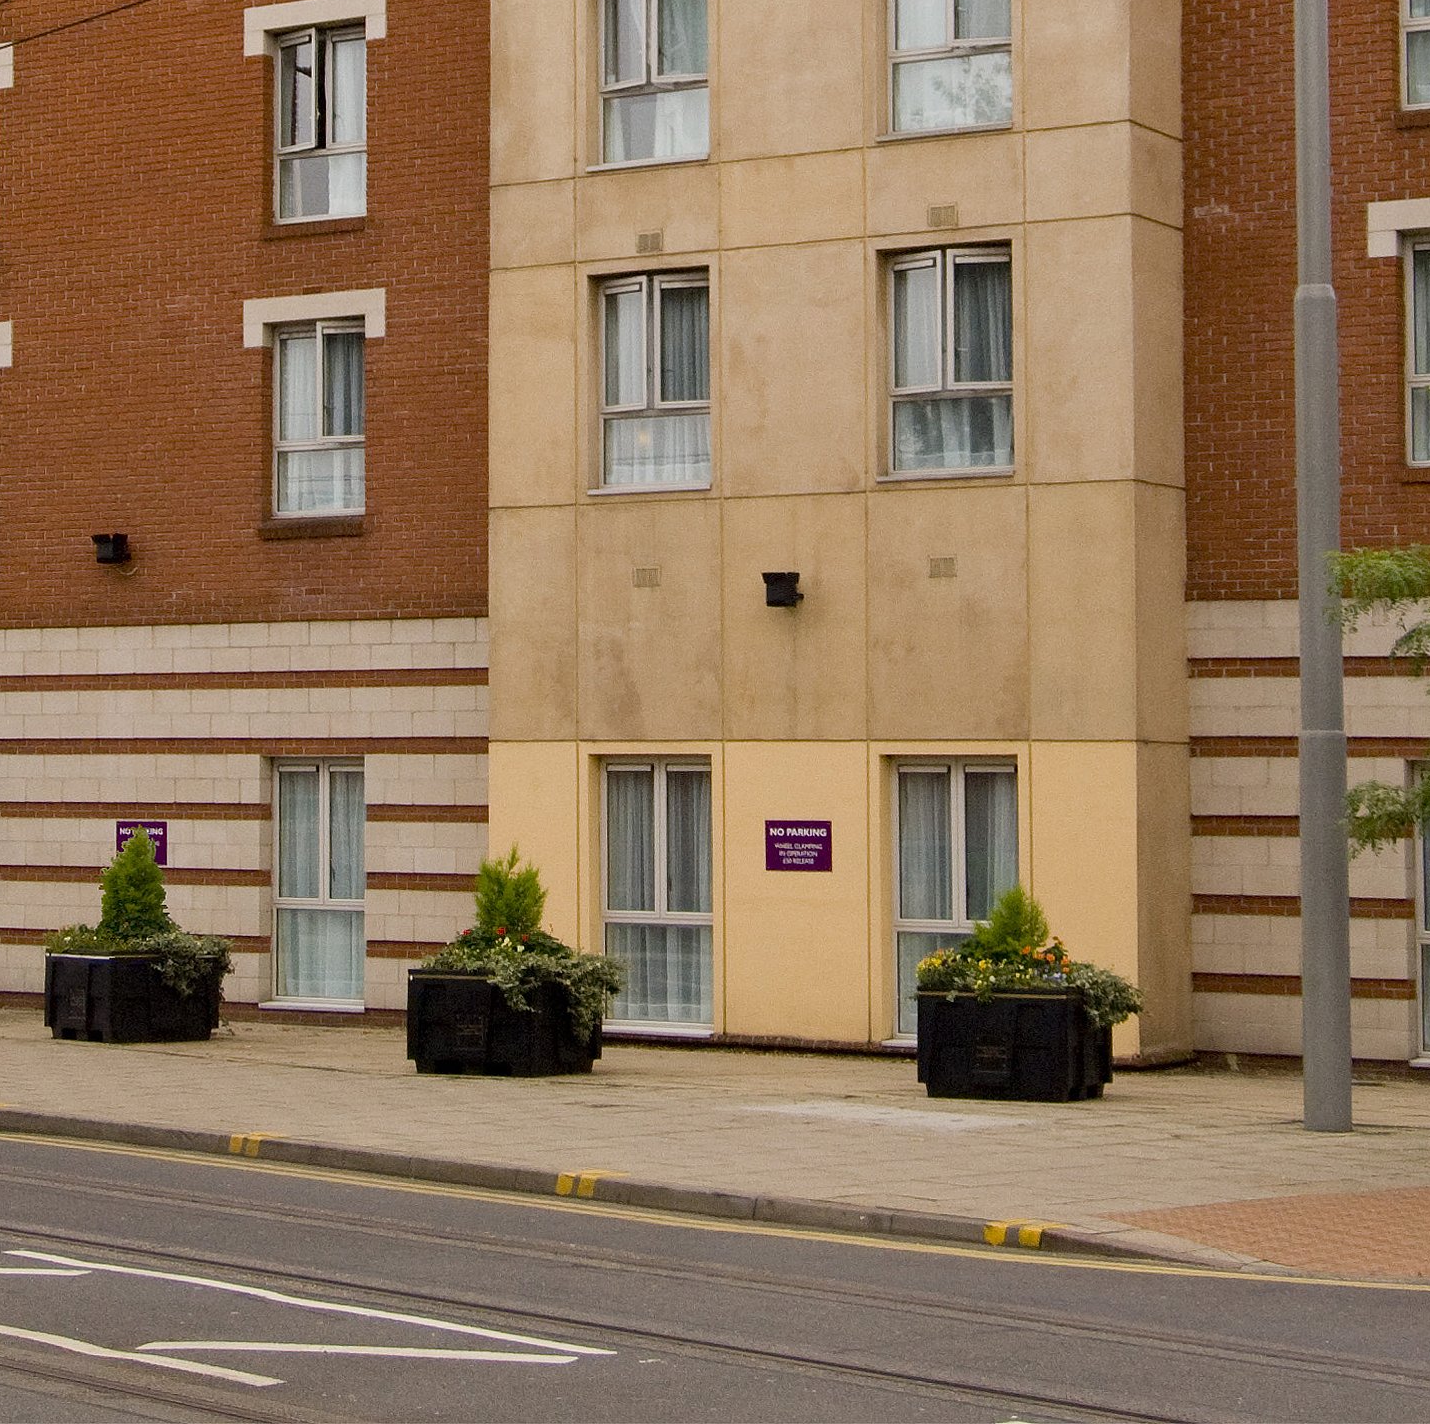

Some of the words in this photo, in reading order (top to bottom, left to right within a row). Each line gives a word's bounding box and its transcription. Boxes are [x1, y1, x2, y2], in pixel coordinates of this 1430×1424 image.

[119, 827, 131, 835] NO
[769, 828, 785, 837] NO
[786, 828, 828, 837] PARKING
